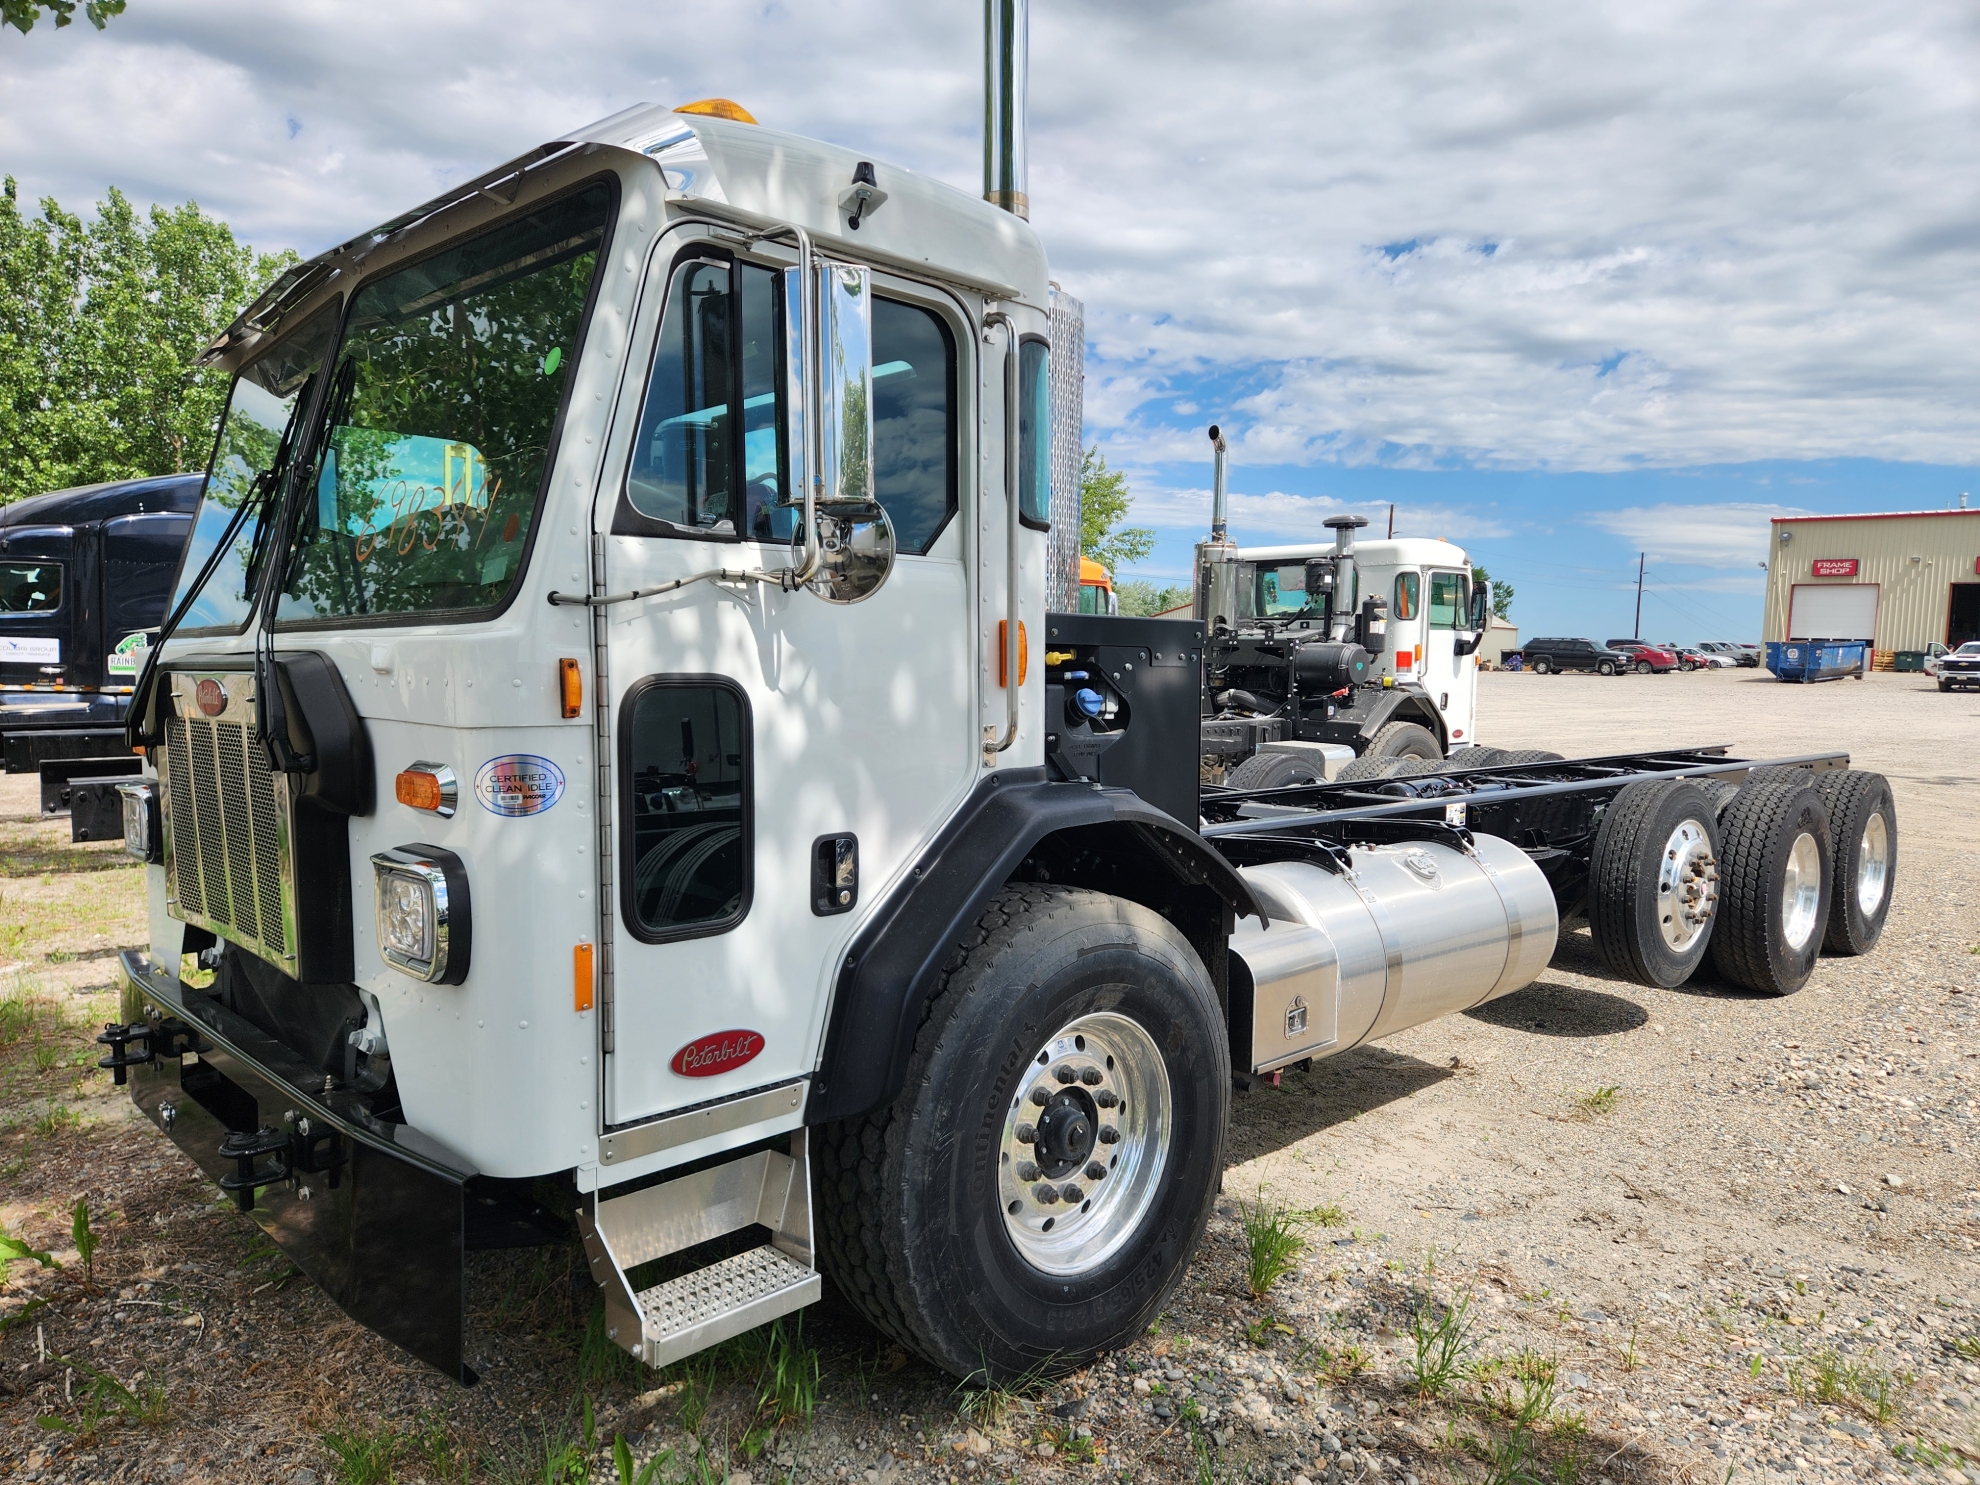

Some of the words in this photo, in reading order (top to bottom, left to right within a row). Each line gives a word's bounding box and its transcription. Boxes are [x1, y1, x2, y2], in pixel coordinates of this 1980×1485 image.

[1819, 567, 1850, 575] SHOP
[489, 773, 547, 783] CERTIFIED
[485, 785, 523, 793] CLEAN
[527, 782, 553, 792] IDLE
[681, 1034, 758, 1073] Peterbilt
